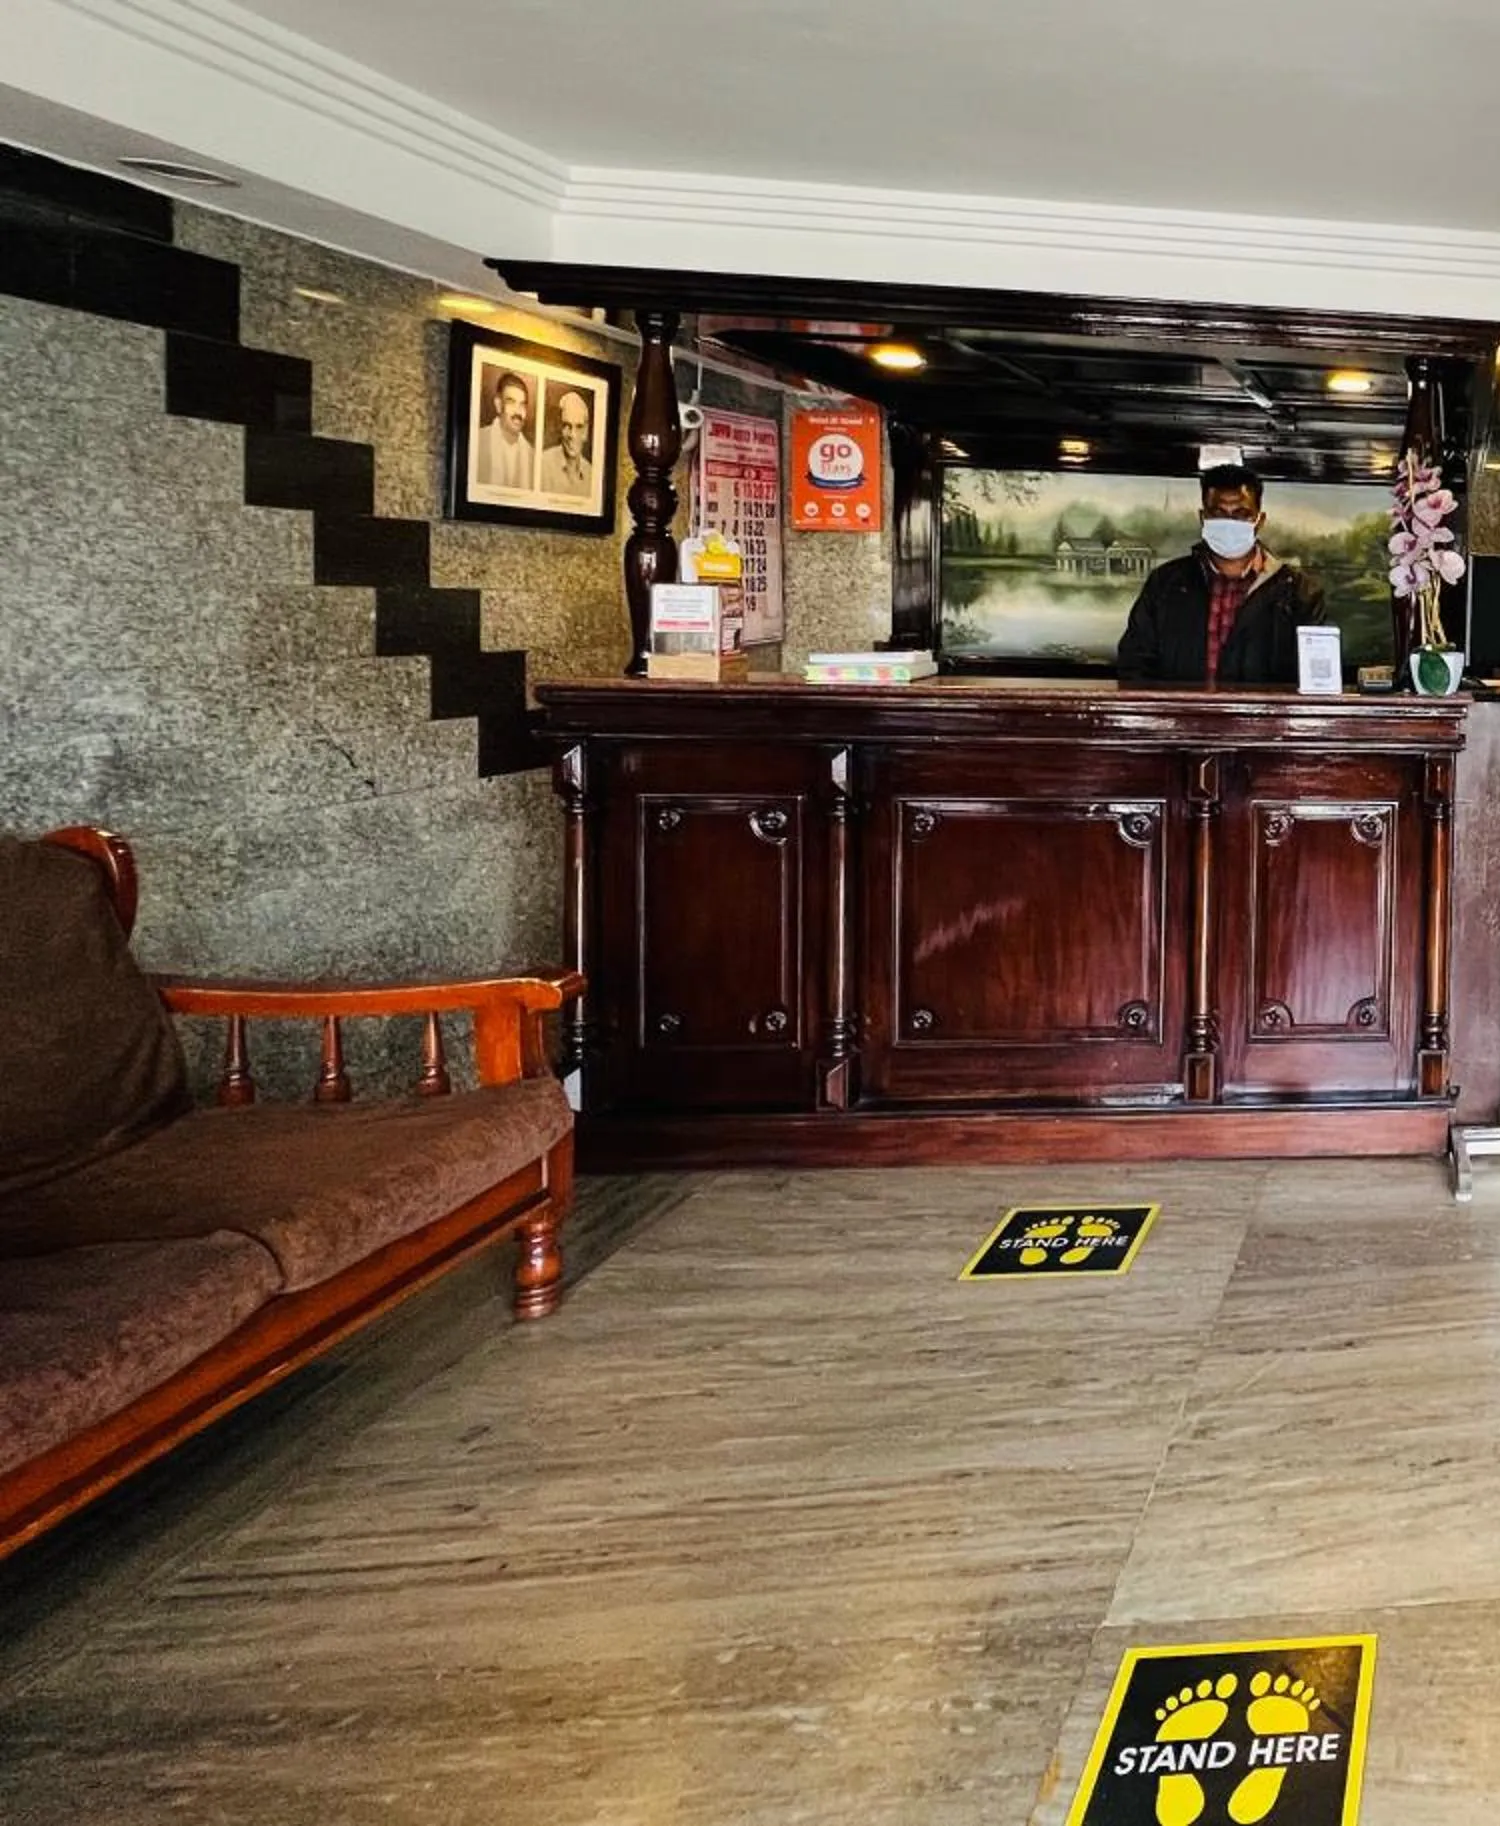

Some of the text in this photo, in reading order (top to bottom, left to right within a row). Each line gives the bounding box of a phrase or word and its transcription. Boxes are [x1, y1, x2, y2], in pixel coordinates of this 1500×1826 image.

[820, 443, 852, 463] go
[998, 1235, 1130, 1249] STAND HERE
[1114, 1733, 1341, 1776] STAND HERE
